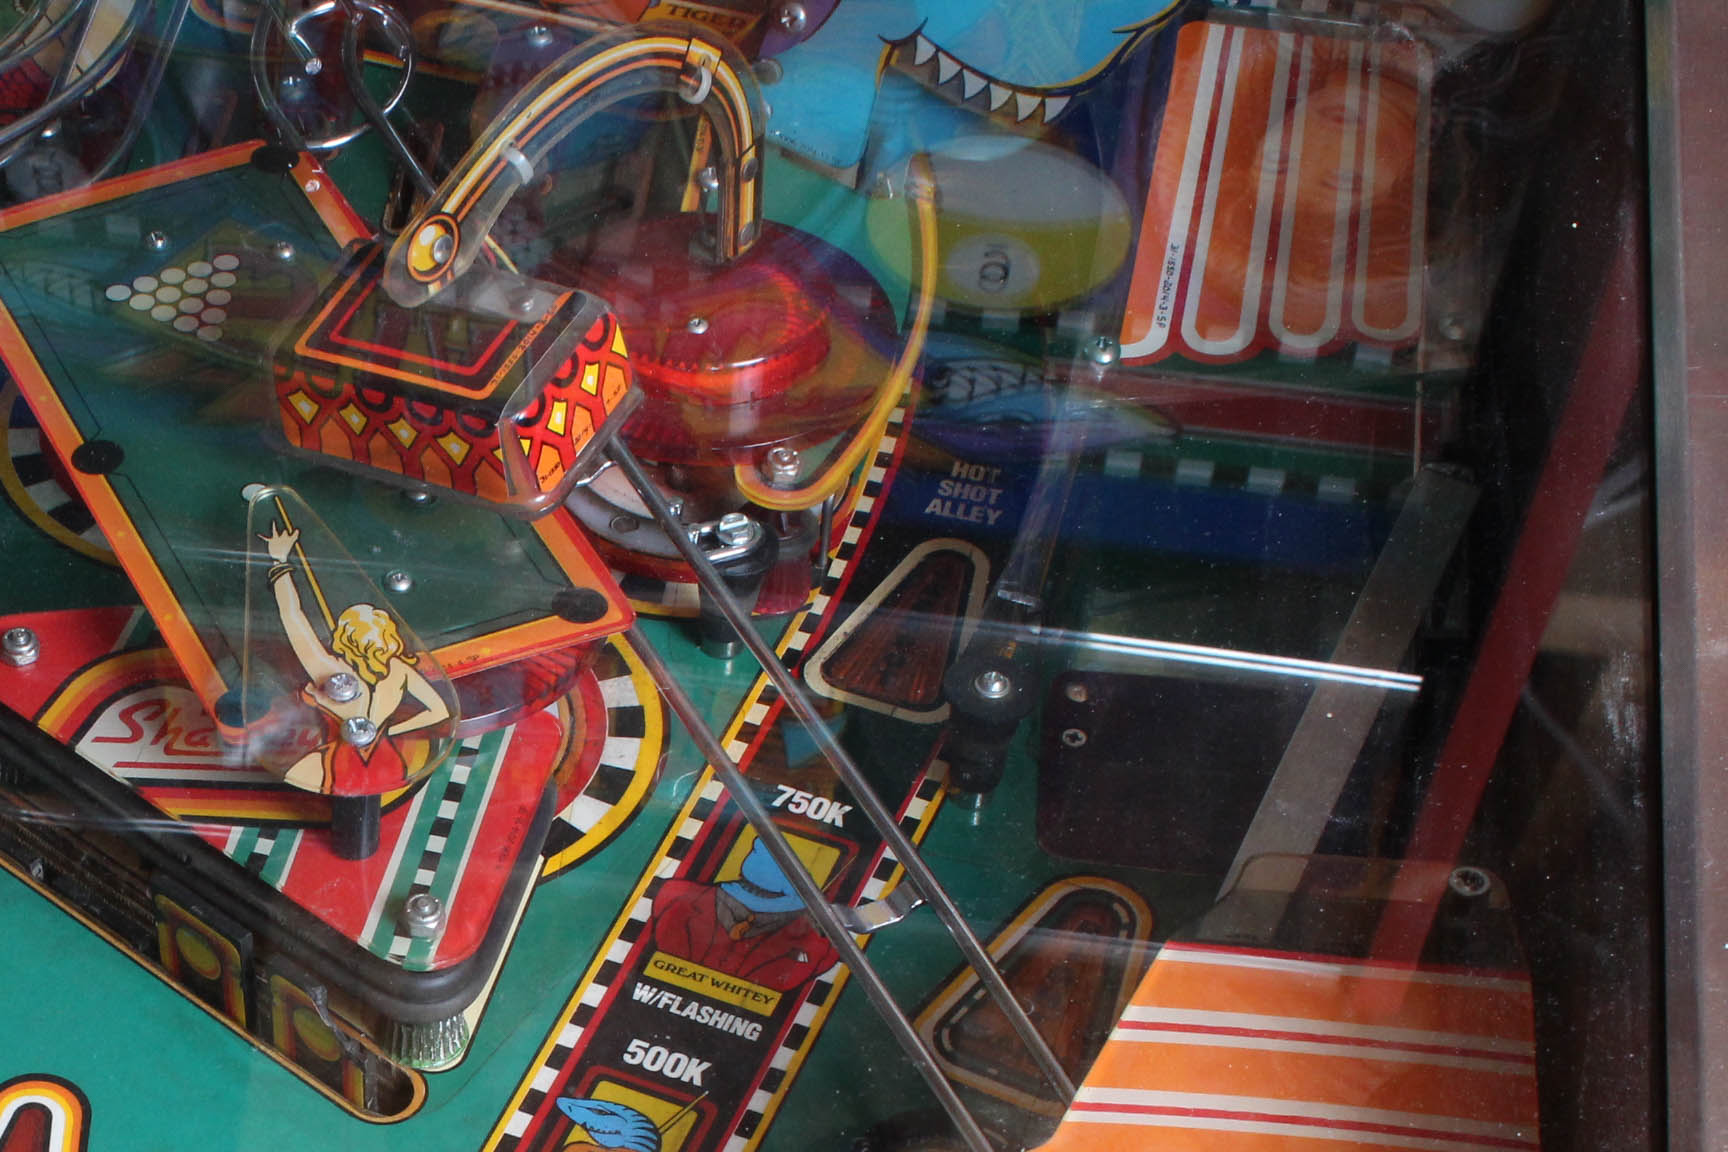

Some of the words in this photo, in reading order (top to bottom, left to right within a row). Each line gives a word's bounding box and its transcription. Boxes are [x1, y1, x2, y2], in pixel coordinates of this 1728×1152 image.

[938, 480, 1003, 503] SHOT
[951, 460, 1002, 484] HOT
[924, 498, 1004, 526] ALLEY
[772, 783, 855, 828] 750K
[653, 959, 708, 983] GREAT
[710, 977, 775, 1005] WHITEY
[632, 982, 764, 1042] W/FLASHING
[622, 1038, 712, 1088] 500K
